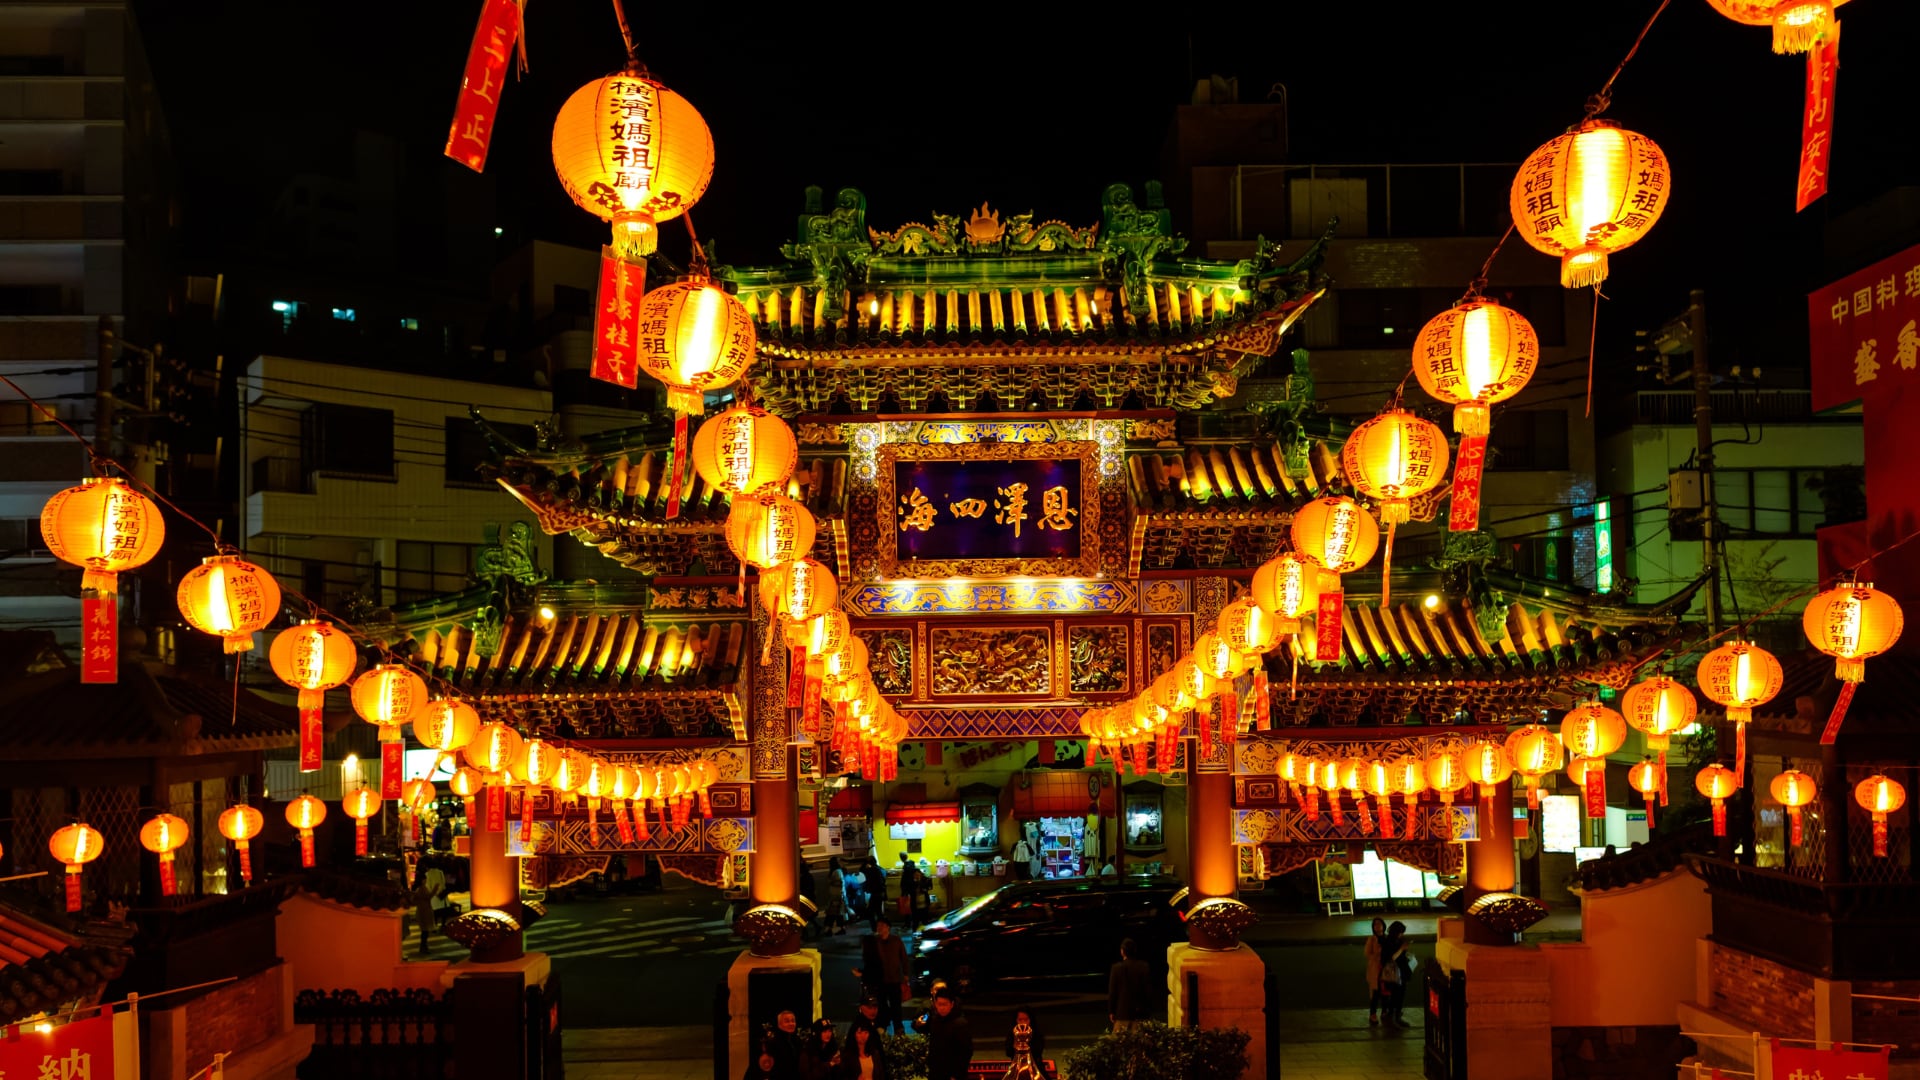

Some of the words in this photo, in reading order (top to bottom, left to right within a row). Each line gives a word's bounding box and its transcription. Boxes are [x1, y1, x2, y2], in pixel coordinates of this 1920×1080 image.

[1831, 264, 1920, 325] 中国料理
[1452, 445, 1484, 524] 心願成就
